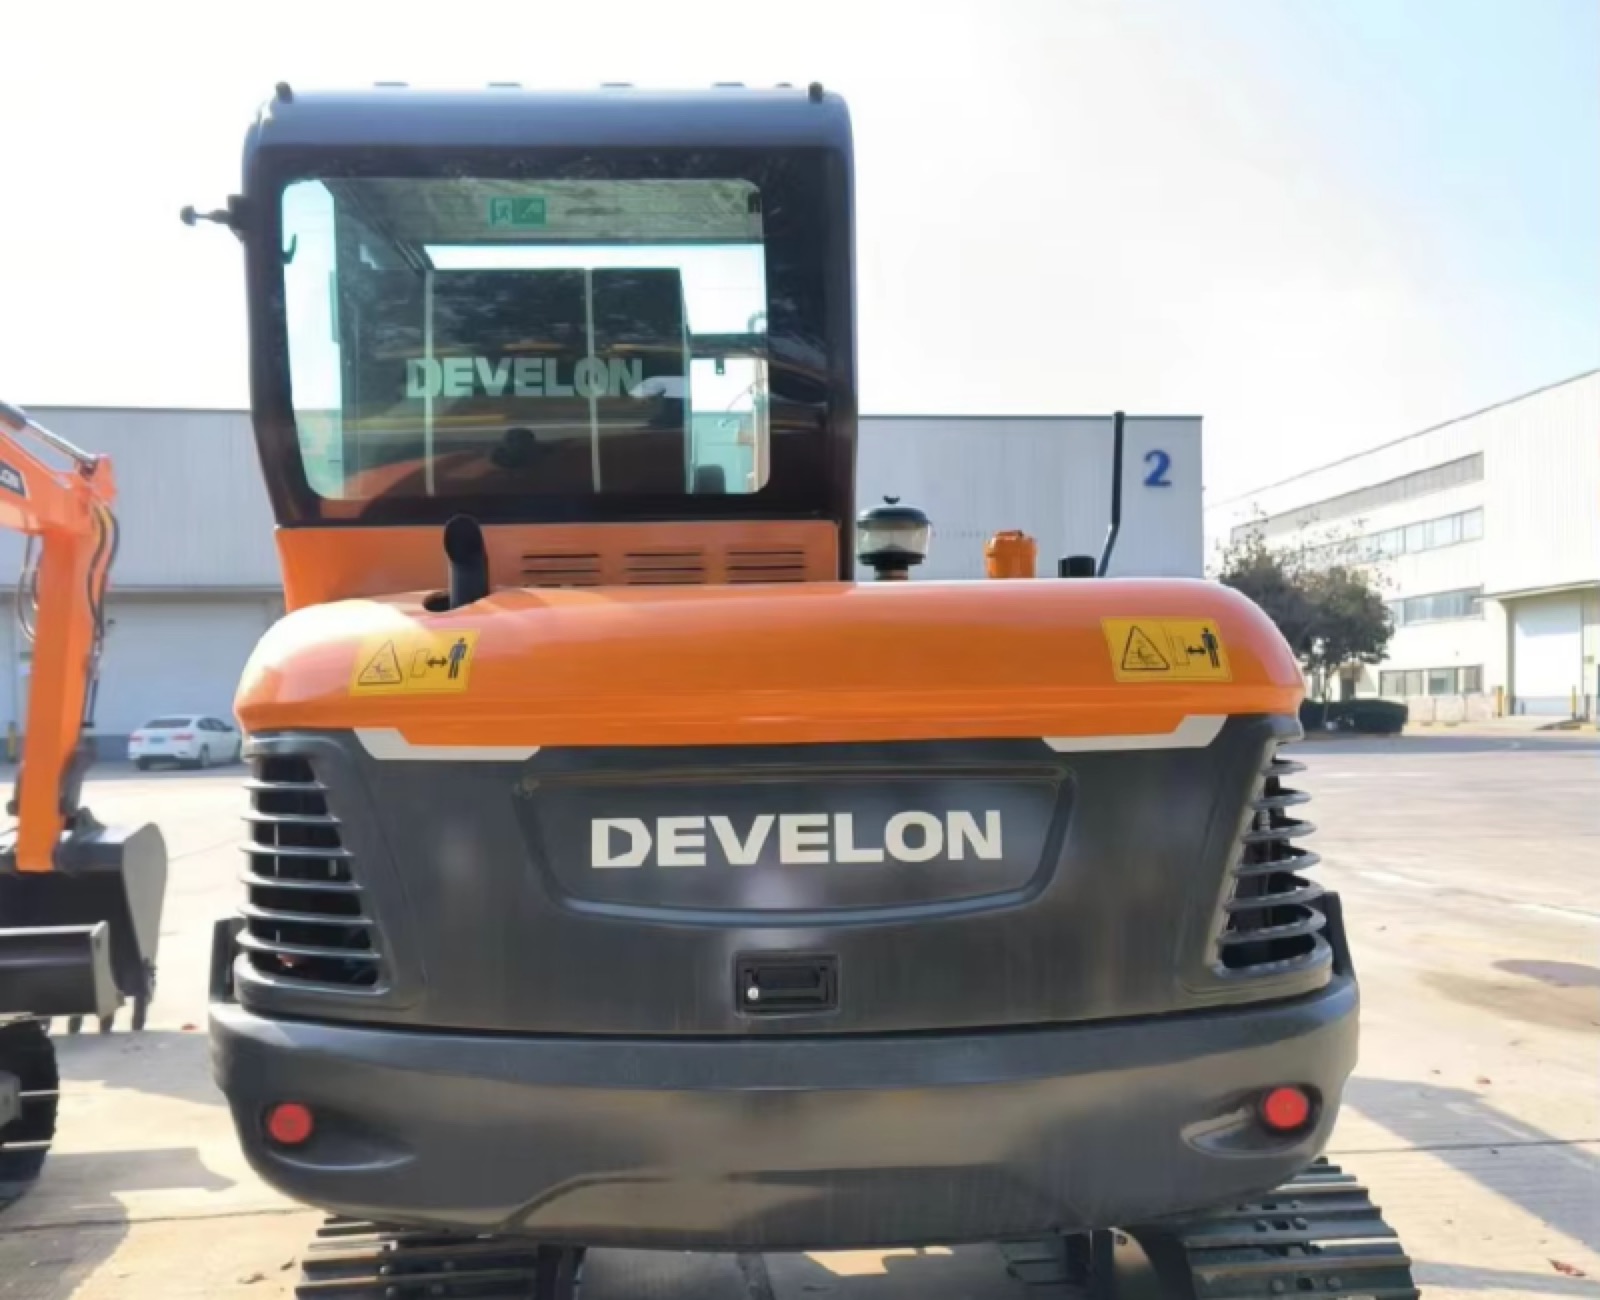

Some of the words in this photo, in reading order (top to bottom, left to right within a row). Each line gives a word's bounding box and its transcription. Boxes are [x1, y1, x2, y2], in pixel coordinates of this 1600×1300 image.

[406, 357, 643, 398] DEVELON
[1143, 449, 1172, 488] 2
[591, 810, 1003, 868] DEVELON
